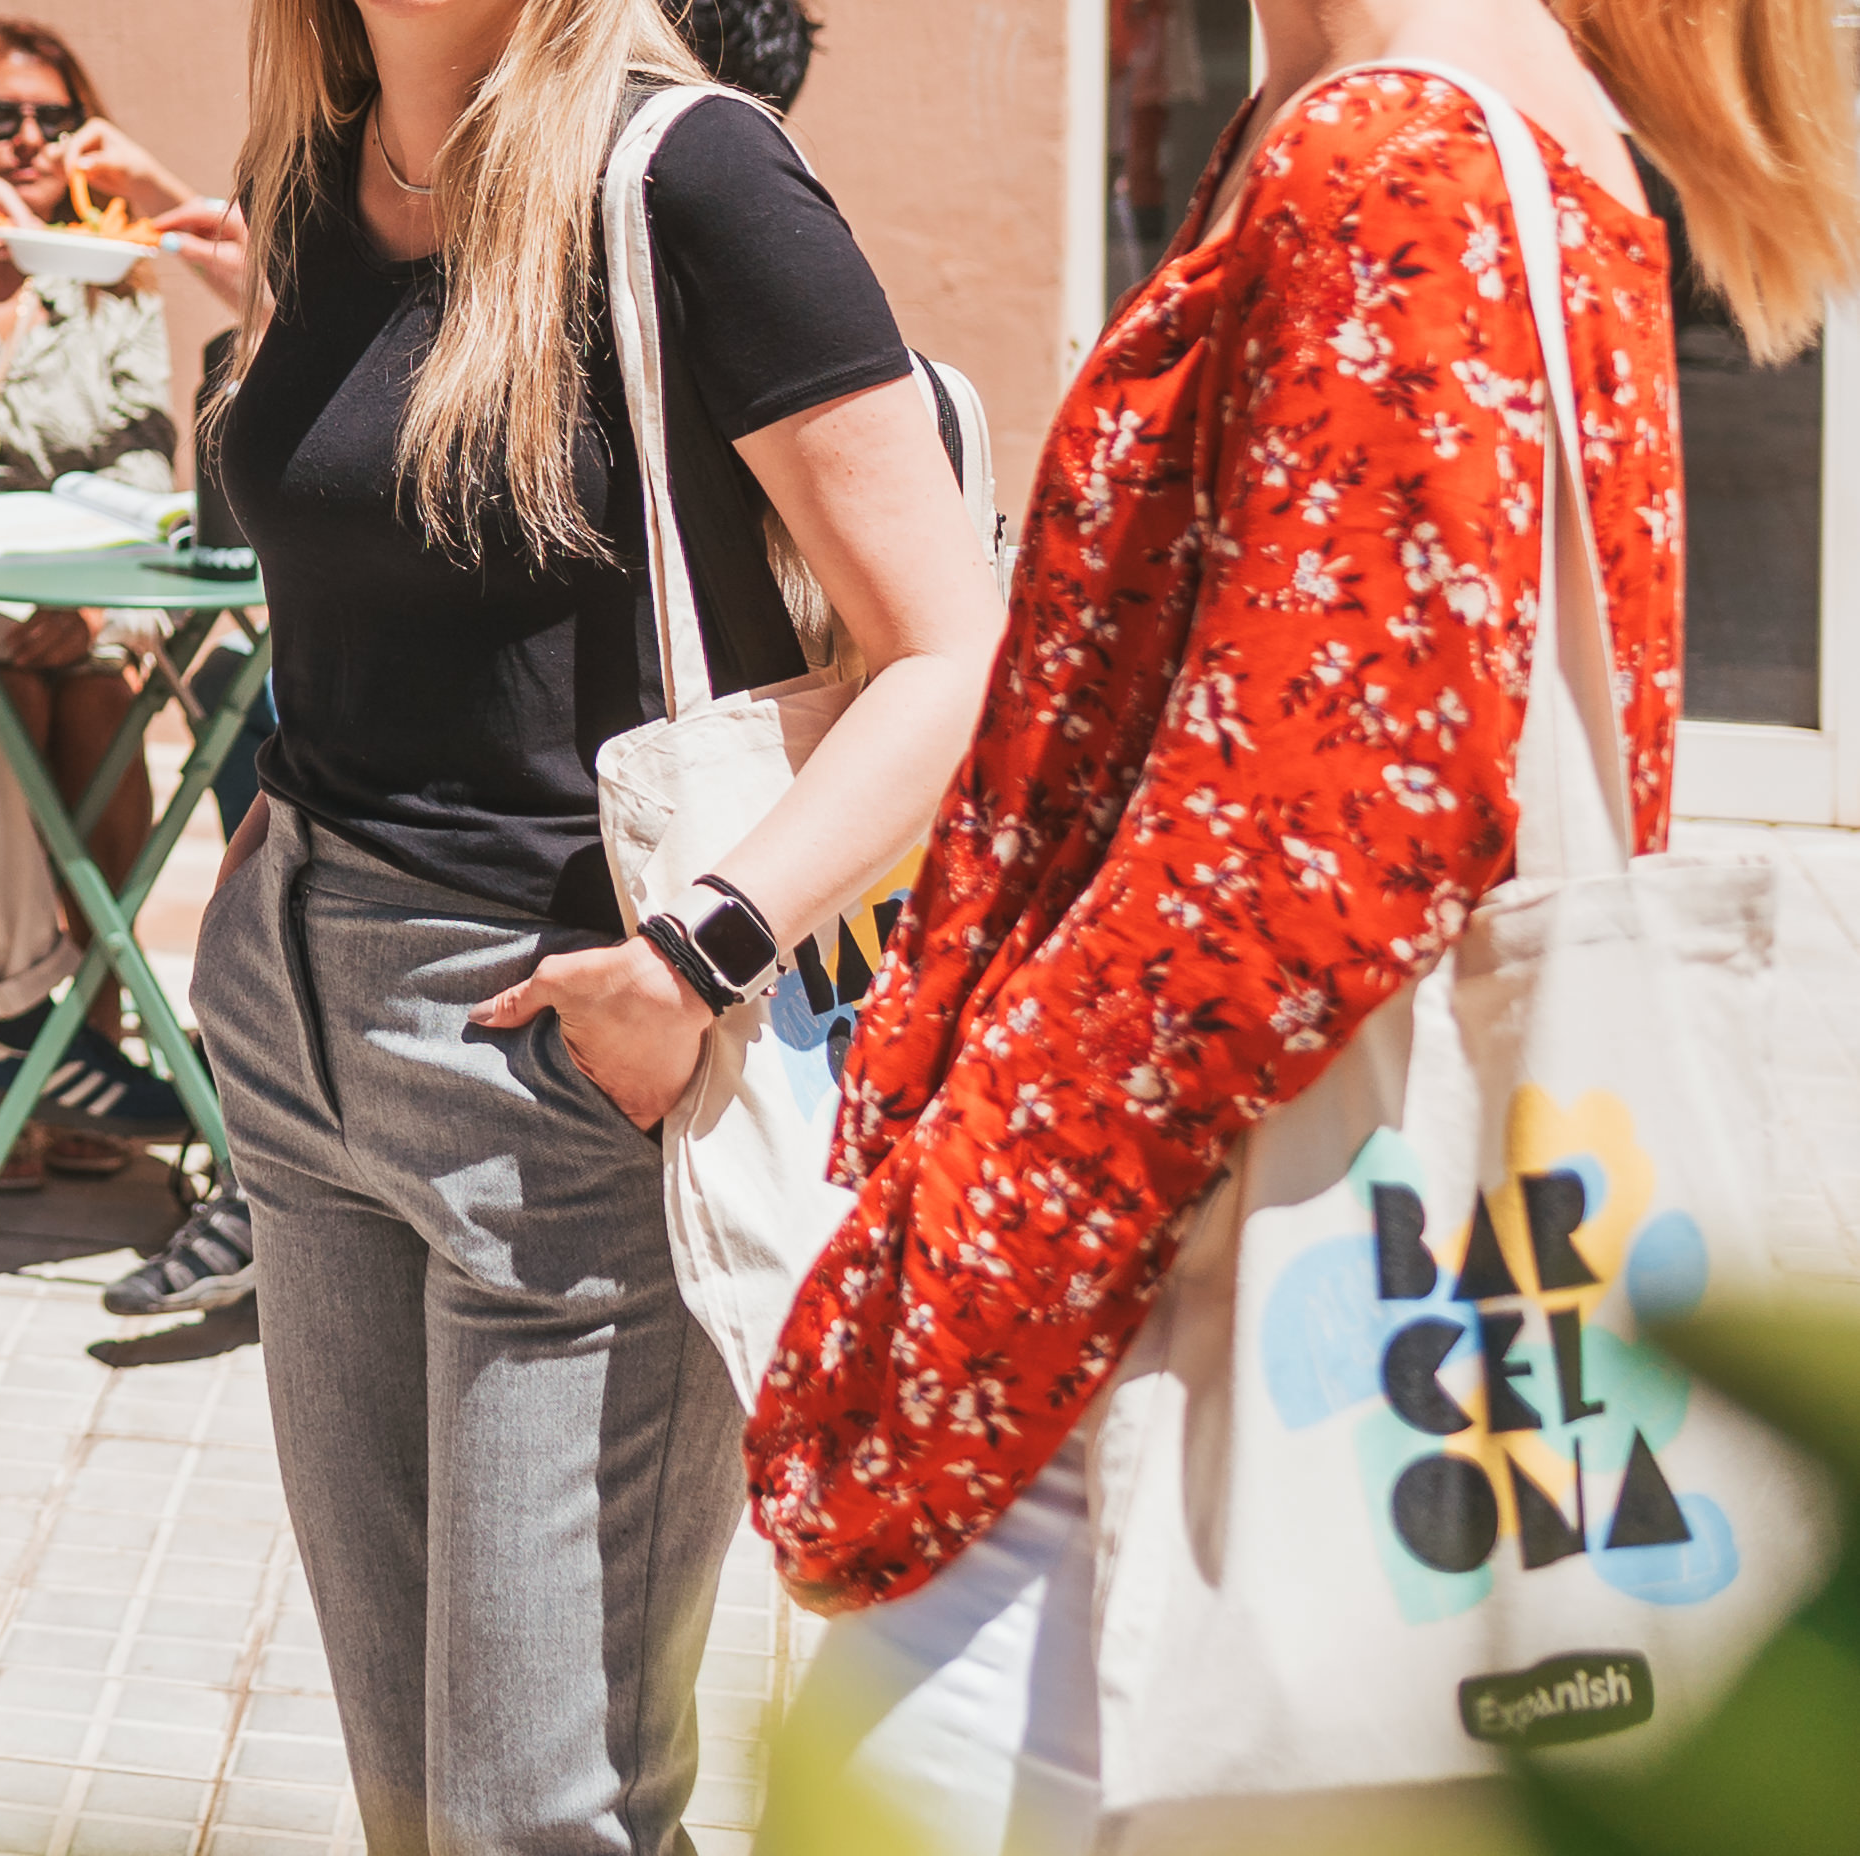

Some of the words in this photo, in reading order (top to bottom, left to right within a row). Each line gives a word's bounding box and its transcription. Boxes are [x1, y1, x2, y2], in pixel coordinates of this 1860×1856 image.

[1369, 1168, 1603, 1302] BAR
[1380, 1305, 1605, 1436] CEL
[1390, 1426, 1693, 1573] ONA
